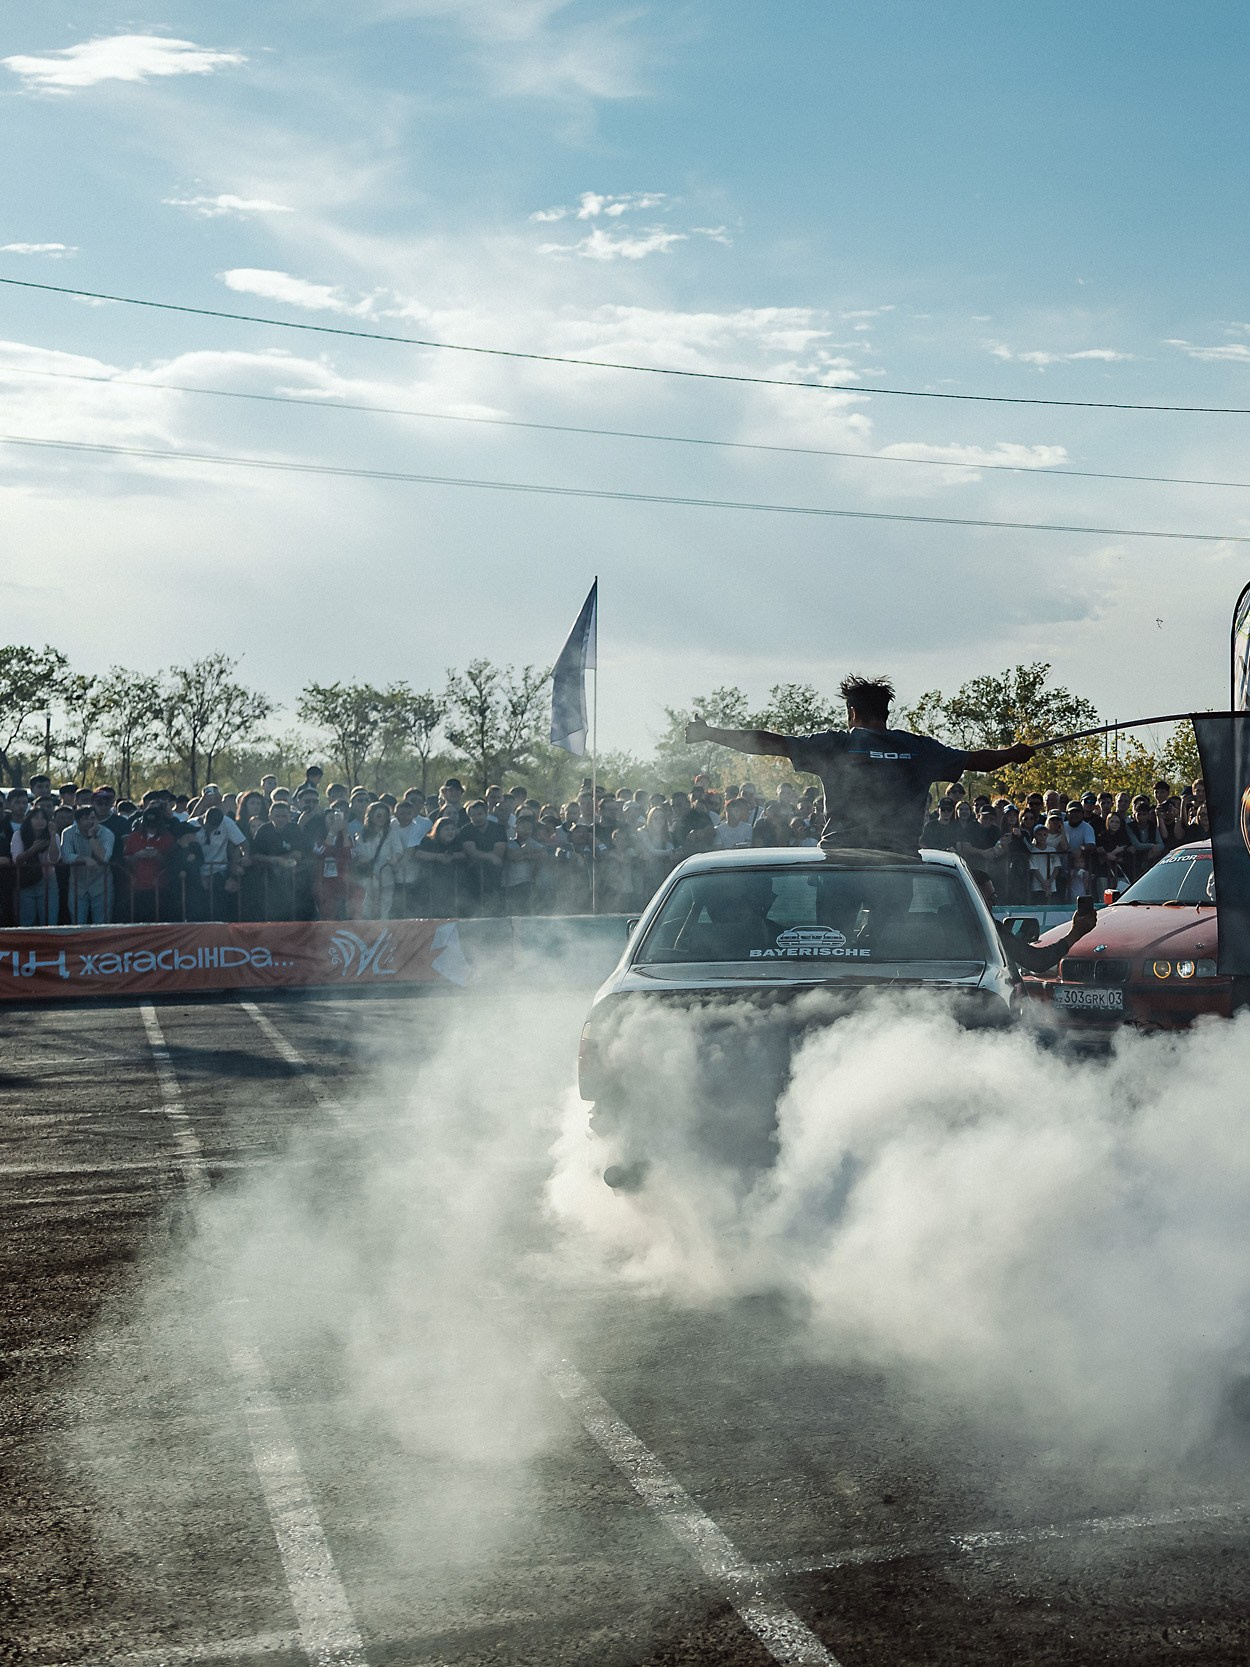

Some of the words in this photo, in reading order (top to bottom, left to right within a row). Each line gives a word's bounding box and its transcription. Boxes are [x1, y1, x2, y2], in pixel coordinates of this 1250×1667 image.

[749, 947, 871, 957] BAYERISCHE
[1063, 990, 1105, 1005] 303GRK
[1108, 992, 1122, 1005] 03
